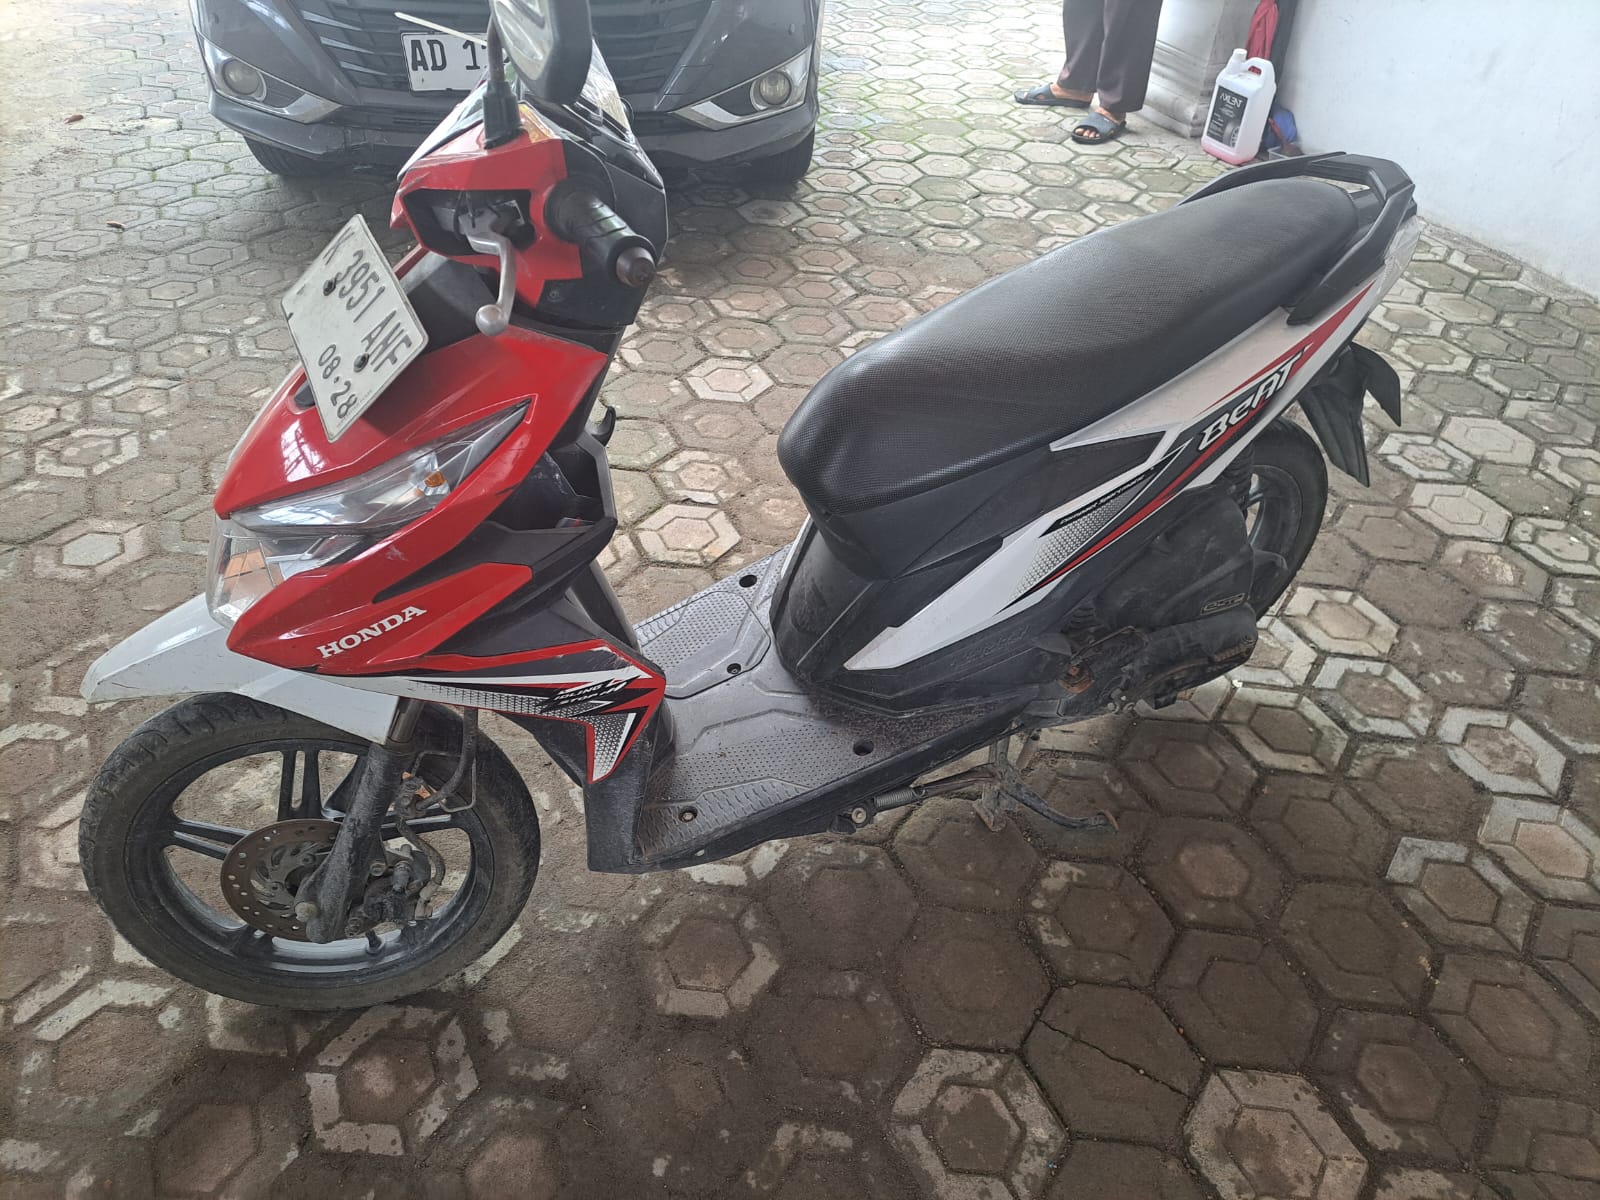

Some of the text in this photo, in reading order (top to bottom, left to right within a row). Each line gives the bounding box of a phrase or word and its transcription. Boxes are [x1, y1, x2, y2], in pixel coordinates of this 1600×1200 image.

[410, 39, 447, 71] AD
[322, 231, 355, 265] K
[335, 249, 386, 323] 3951
[316, 606, 427, 658] HONDA
[553, 684, 604, 701] IDLING
